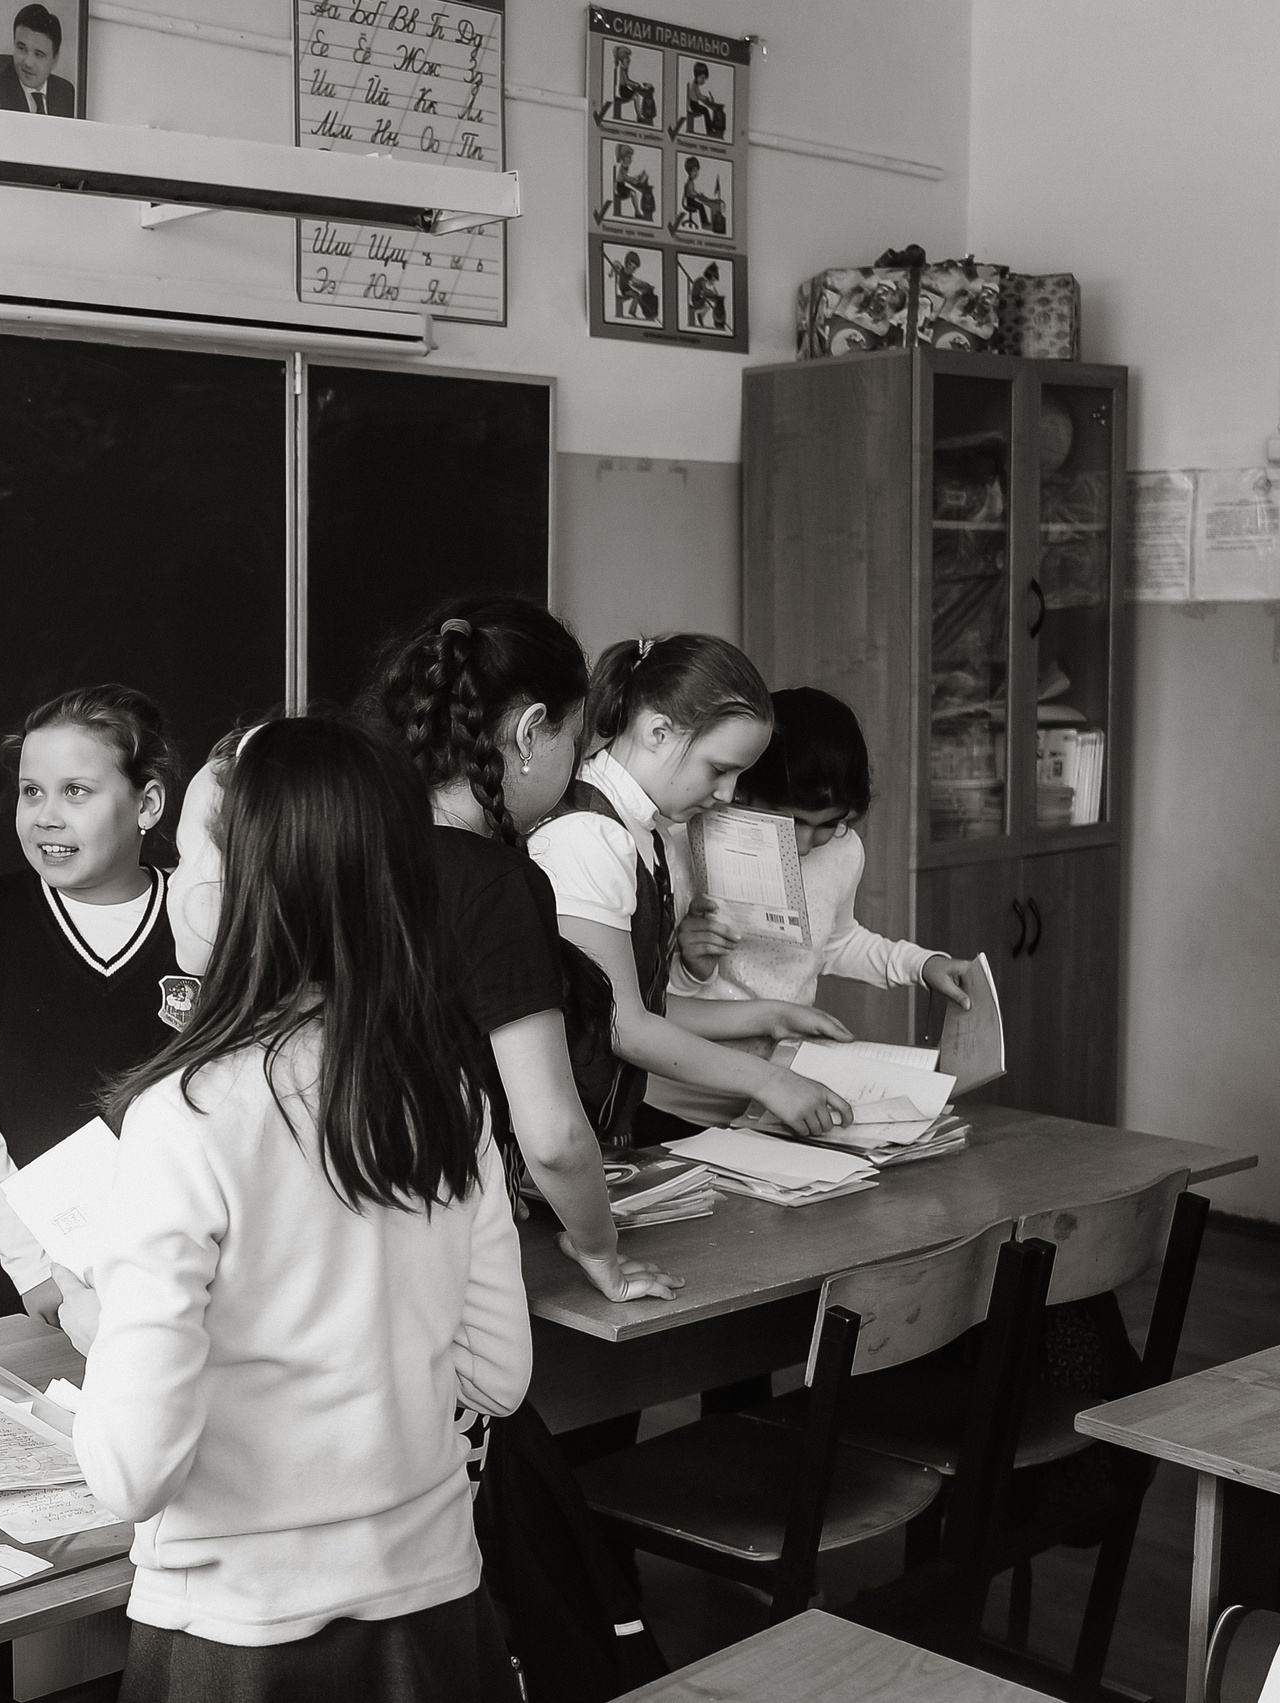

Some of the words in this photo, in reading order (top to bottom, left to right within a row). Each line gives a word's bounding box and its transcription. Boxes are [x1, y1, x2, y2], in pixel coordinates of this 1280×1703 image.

[388, 5, 420, 34] Вв
[426, 13, 450, 40] Гг
[455, 20, 483, 58] Дд
[613, 17, 652, 40] СИДИ
[656, 27, 730, 57] ПРАВИЛЬНО
[311, 30, 330, 58] Ее
[353, 33, 372, 65] Ёё
[394, 44, 441, 77] Жж
[463, 57, 483, 97] Зз
[311, 69, 336, 98] Ии
[365, 75, 390, 106] Йй
[414, 87, 438, 115] Кк
[458, 95, 484, 123] Лл
[311, 110, 353, 140] Мм
[371, 118, 400, 147] Нн
[421, 126, 440, 154] Оо
[456, 132, 483, 160] Пп
[313, 227, 352, 257] Шш
[369, 234, 408, 270] Щщ
[313, 267, 336, 295] Ээ
[364, 273, 399, 301] Юю
[421, 279, 450, 306] Яя
